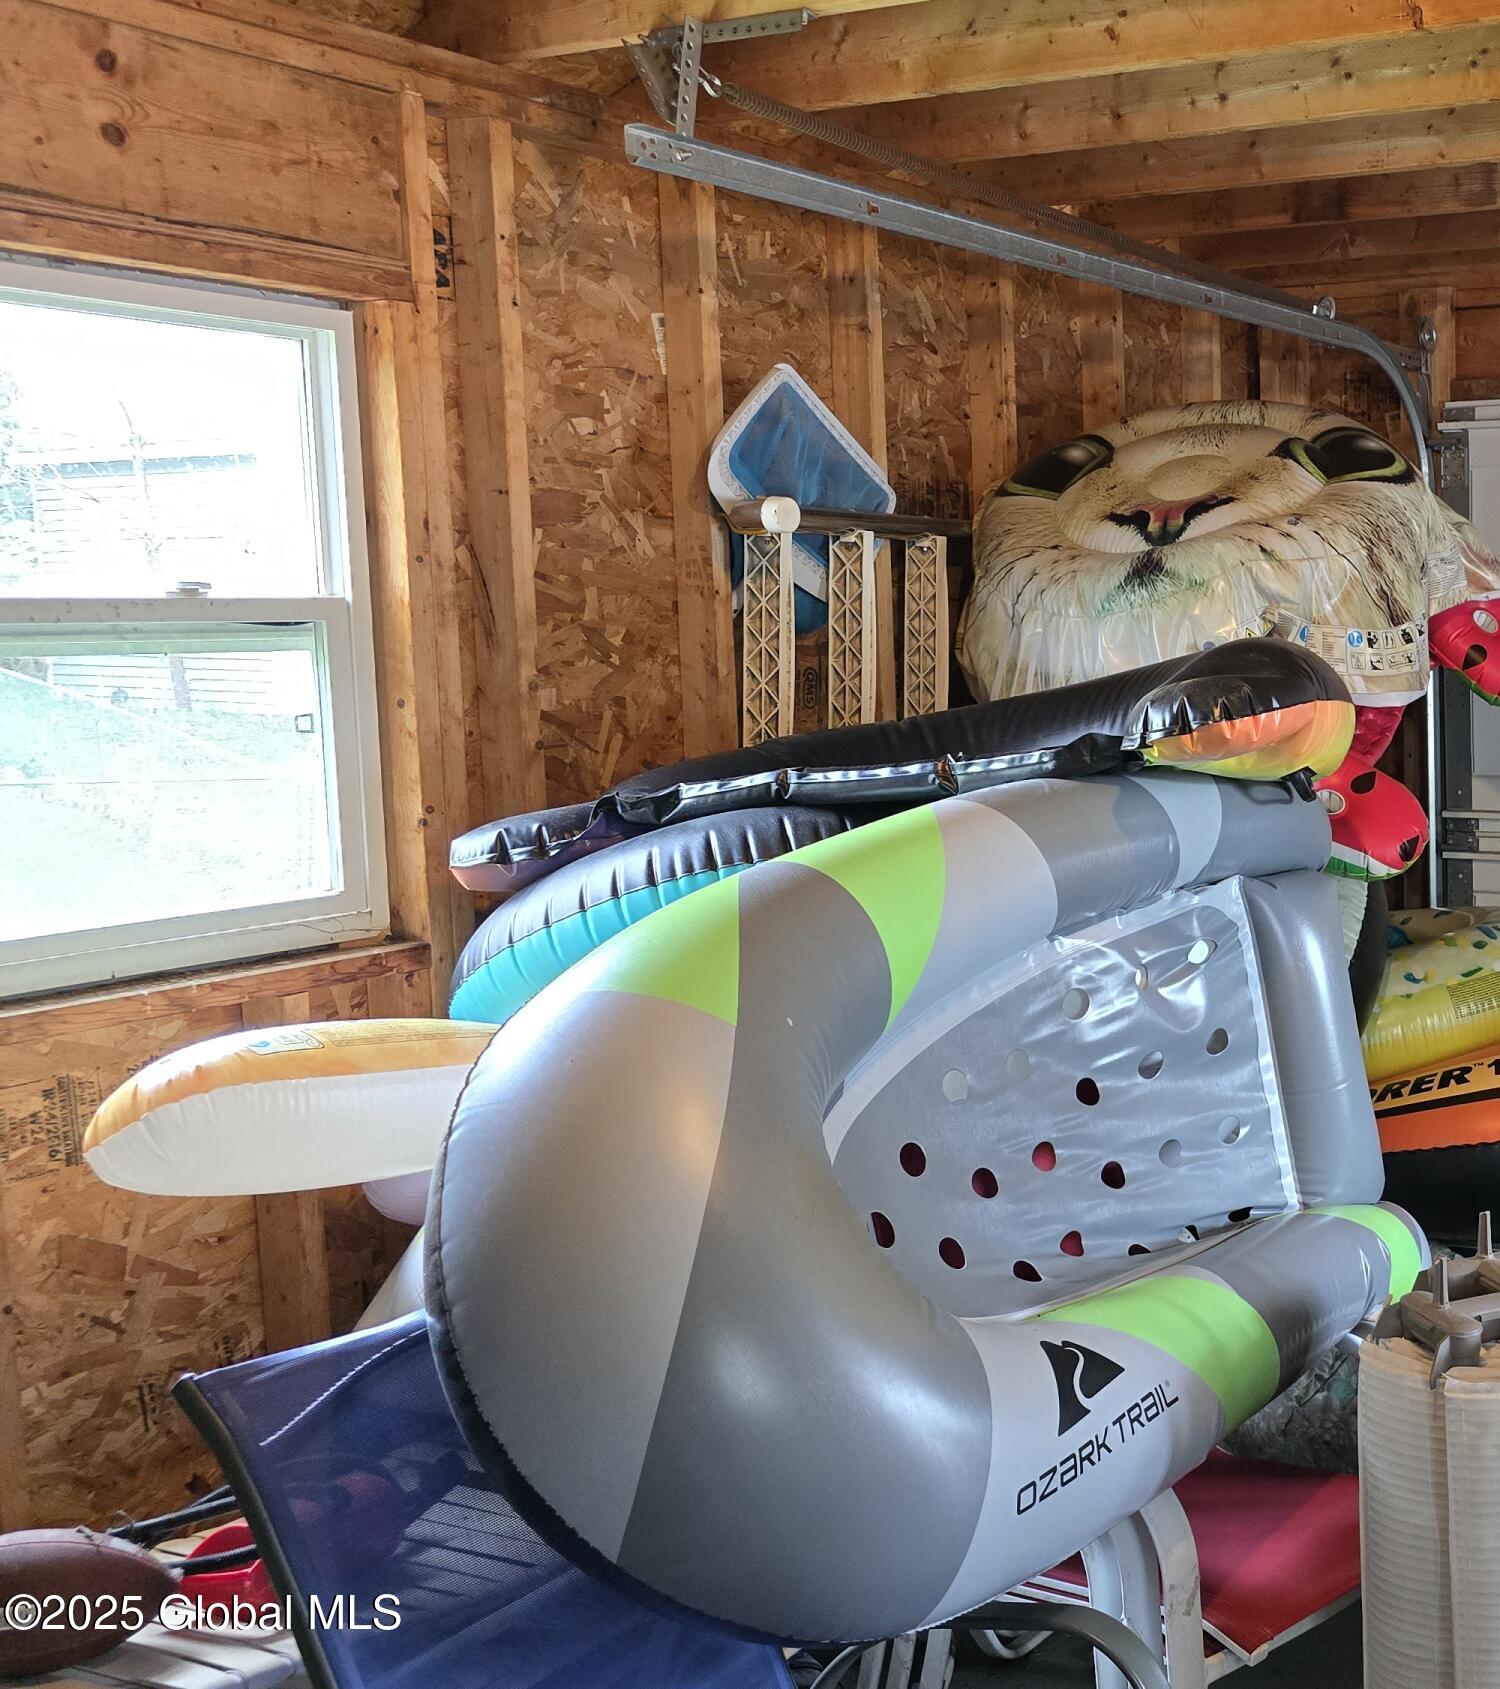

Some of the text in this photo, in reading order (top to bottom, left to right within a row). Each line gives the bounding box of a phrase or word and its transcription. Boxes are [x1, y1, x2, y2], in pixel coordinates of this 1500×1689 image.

[805, 671, 815, 705] QMS
[1016, 1384, 1179, 1516] OZARK TRAIL
